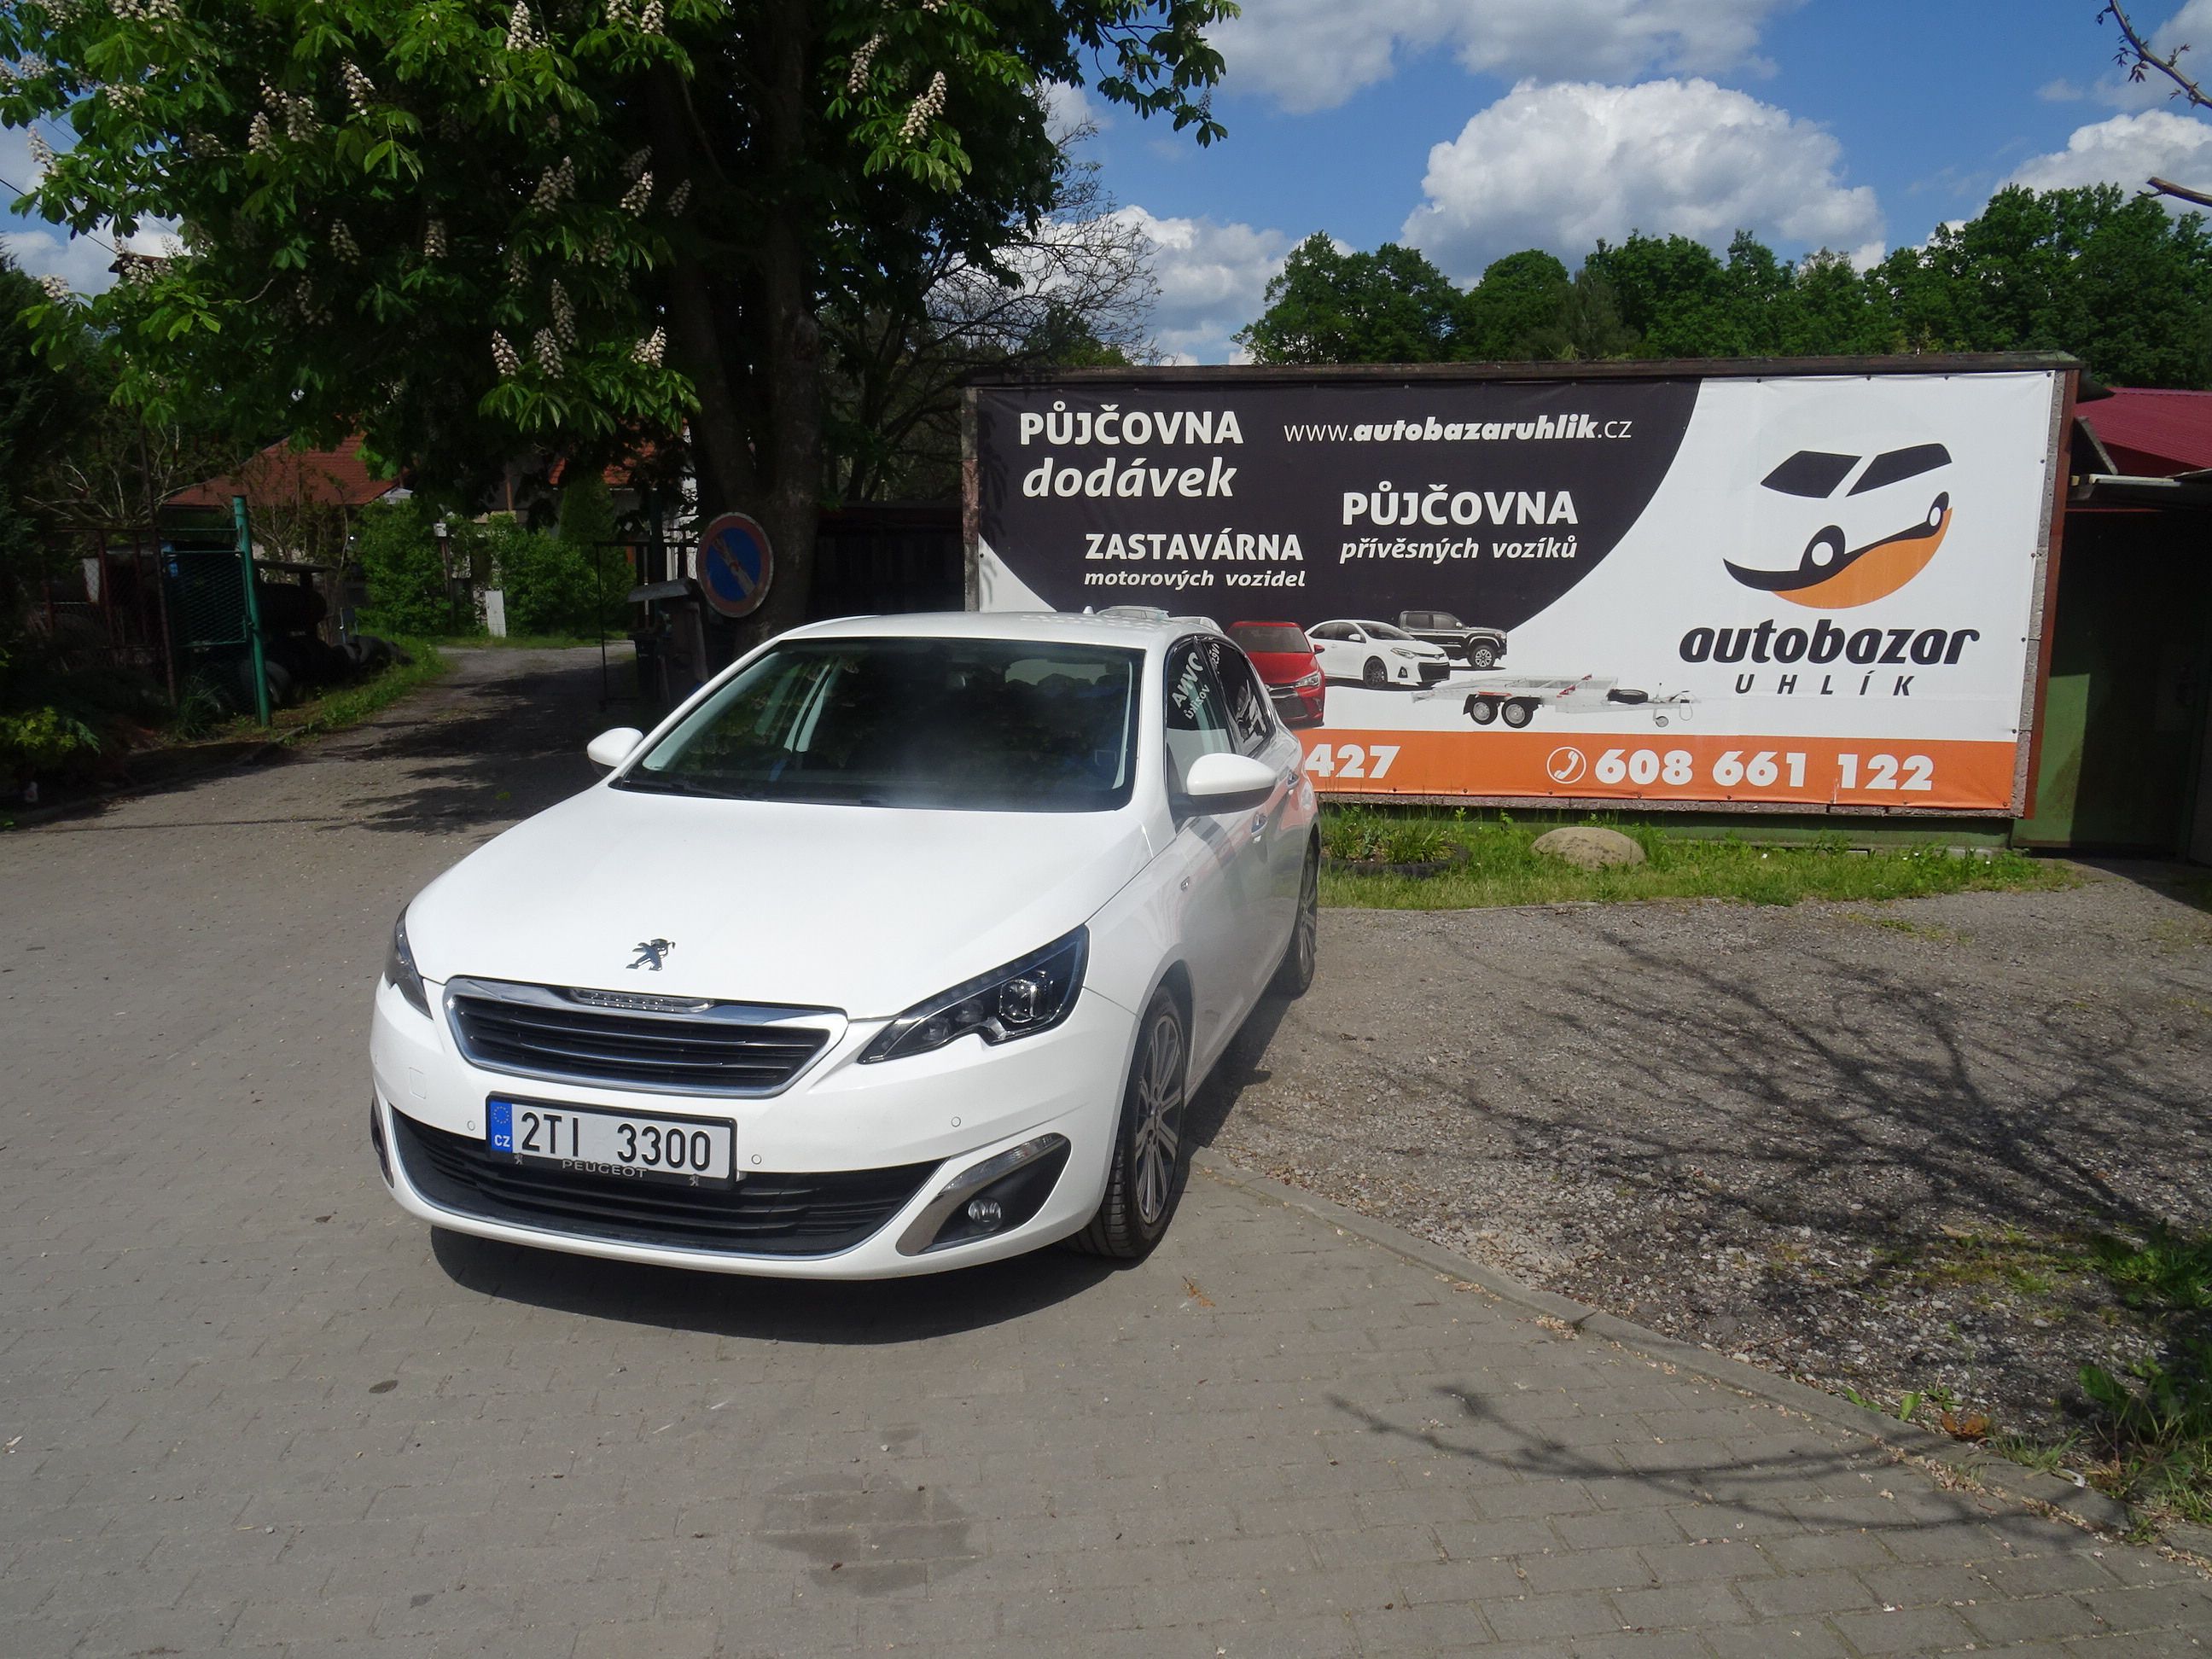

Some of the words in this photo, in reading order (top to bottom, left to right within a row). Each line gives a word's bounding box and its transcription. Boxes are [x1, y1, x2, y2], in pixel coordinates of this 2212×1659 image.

[1020, 400, 1244, 445] PŮJČOVNA
[1283, 413, 1633, 442] www.autobazaruhlik.cz
[1022, 456, 1237, 498] dodávek
[1342, 480, 1579, 526] PŮJČOVNA
[1085, 527, 1304, 561] ZASTAVÁRNA
[1339, 537, 1479, 565] přívěsných
[1492, 534, 1578, 559] vozíků
[1084, 569, 1214, 591] motorových
[1225, 570, 1306, 587] vozidel
[1679, 619, 1981, 666] autobazar
[1735, 670, 1915, 696] UHLÍK
[1304, 743, 1401, 779] 427
[1594, 748, 1694, 786] 608
[1712, 750, 1807, 788] 661
[1837, 753, 1935, 791] 122
[494, 1134, 510, 1148] CZ
[617, 1124, 711, 1172] 3300
[562, 1159, 648, 1179] PEUGEOT
